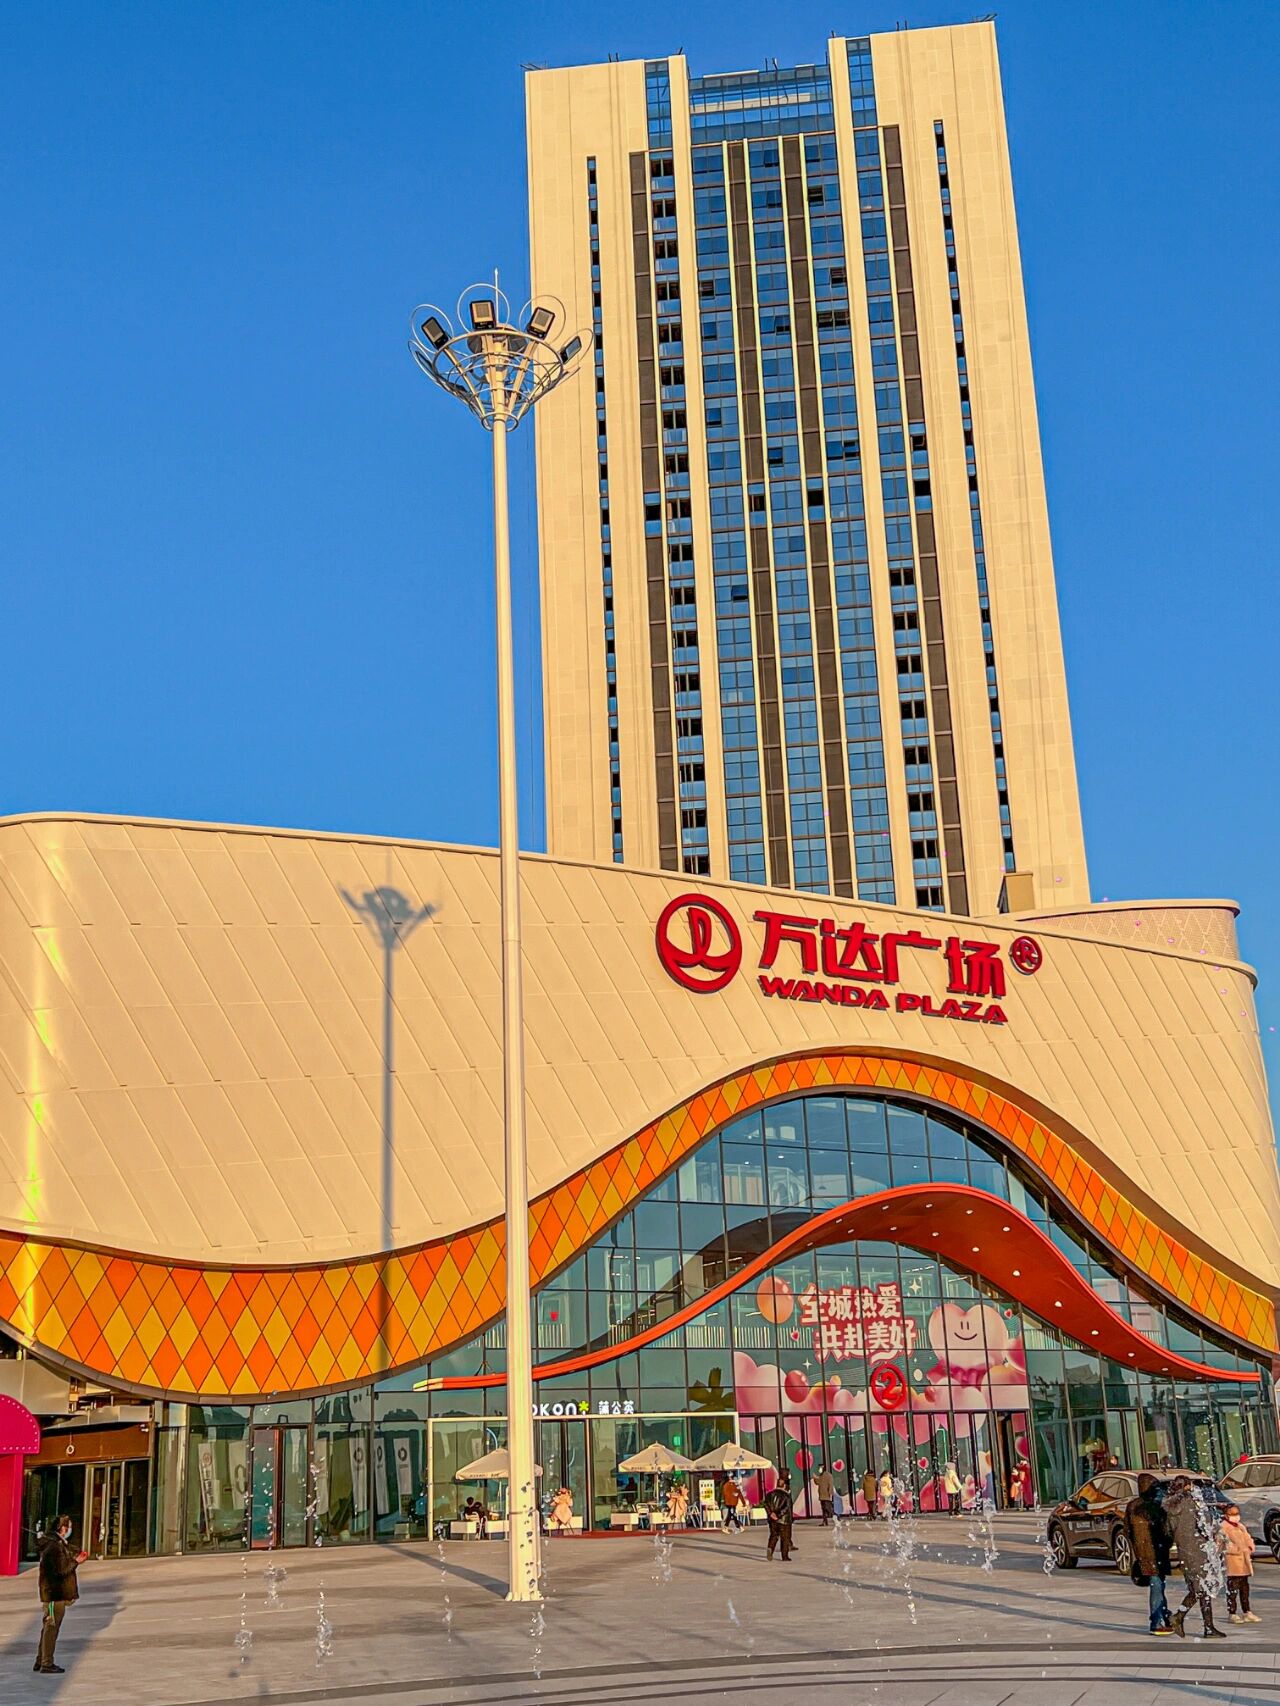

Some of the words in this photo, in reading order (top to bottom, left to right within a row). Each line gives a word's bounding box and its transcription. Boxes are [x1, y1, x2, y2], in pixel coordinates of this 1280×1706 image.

[753, 910, 1007, 998] 万达广场
[758, 974, 891, 1011] WANDA
[895, 991, 1009, 1026] PLAZA
[798, 1283, 902, 1324] 全城热爱
[814, 1318, 917, 1362] 共赴美好
[598, 1400, 634, 1415] 蒲公英
